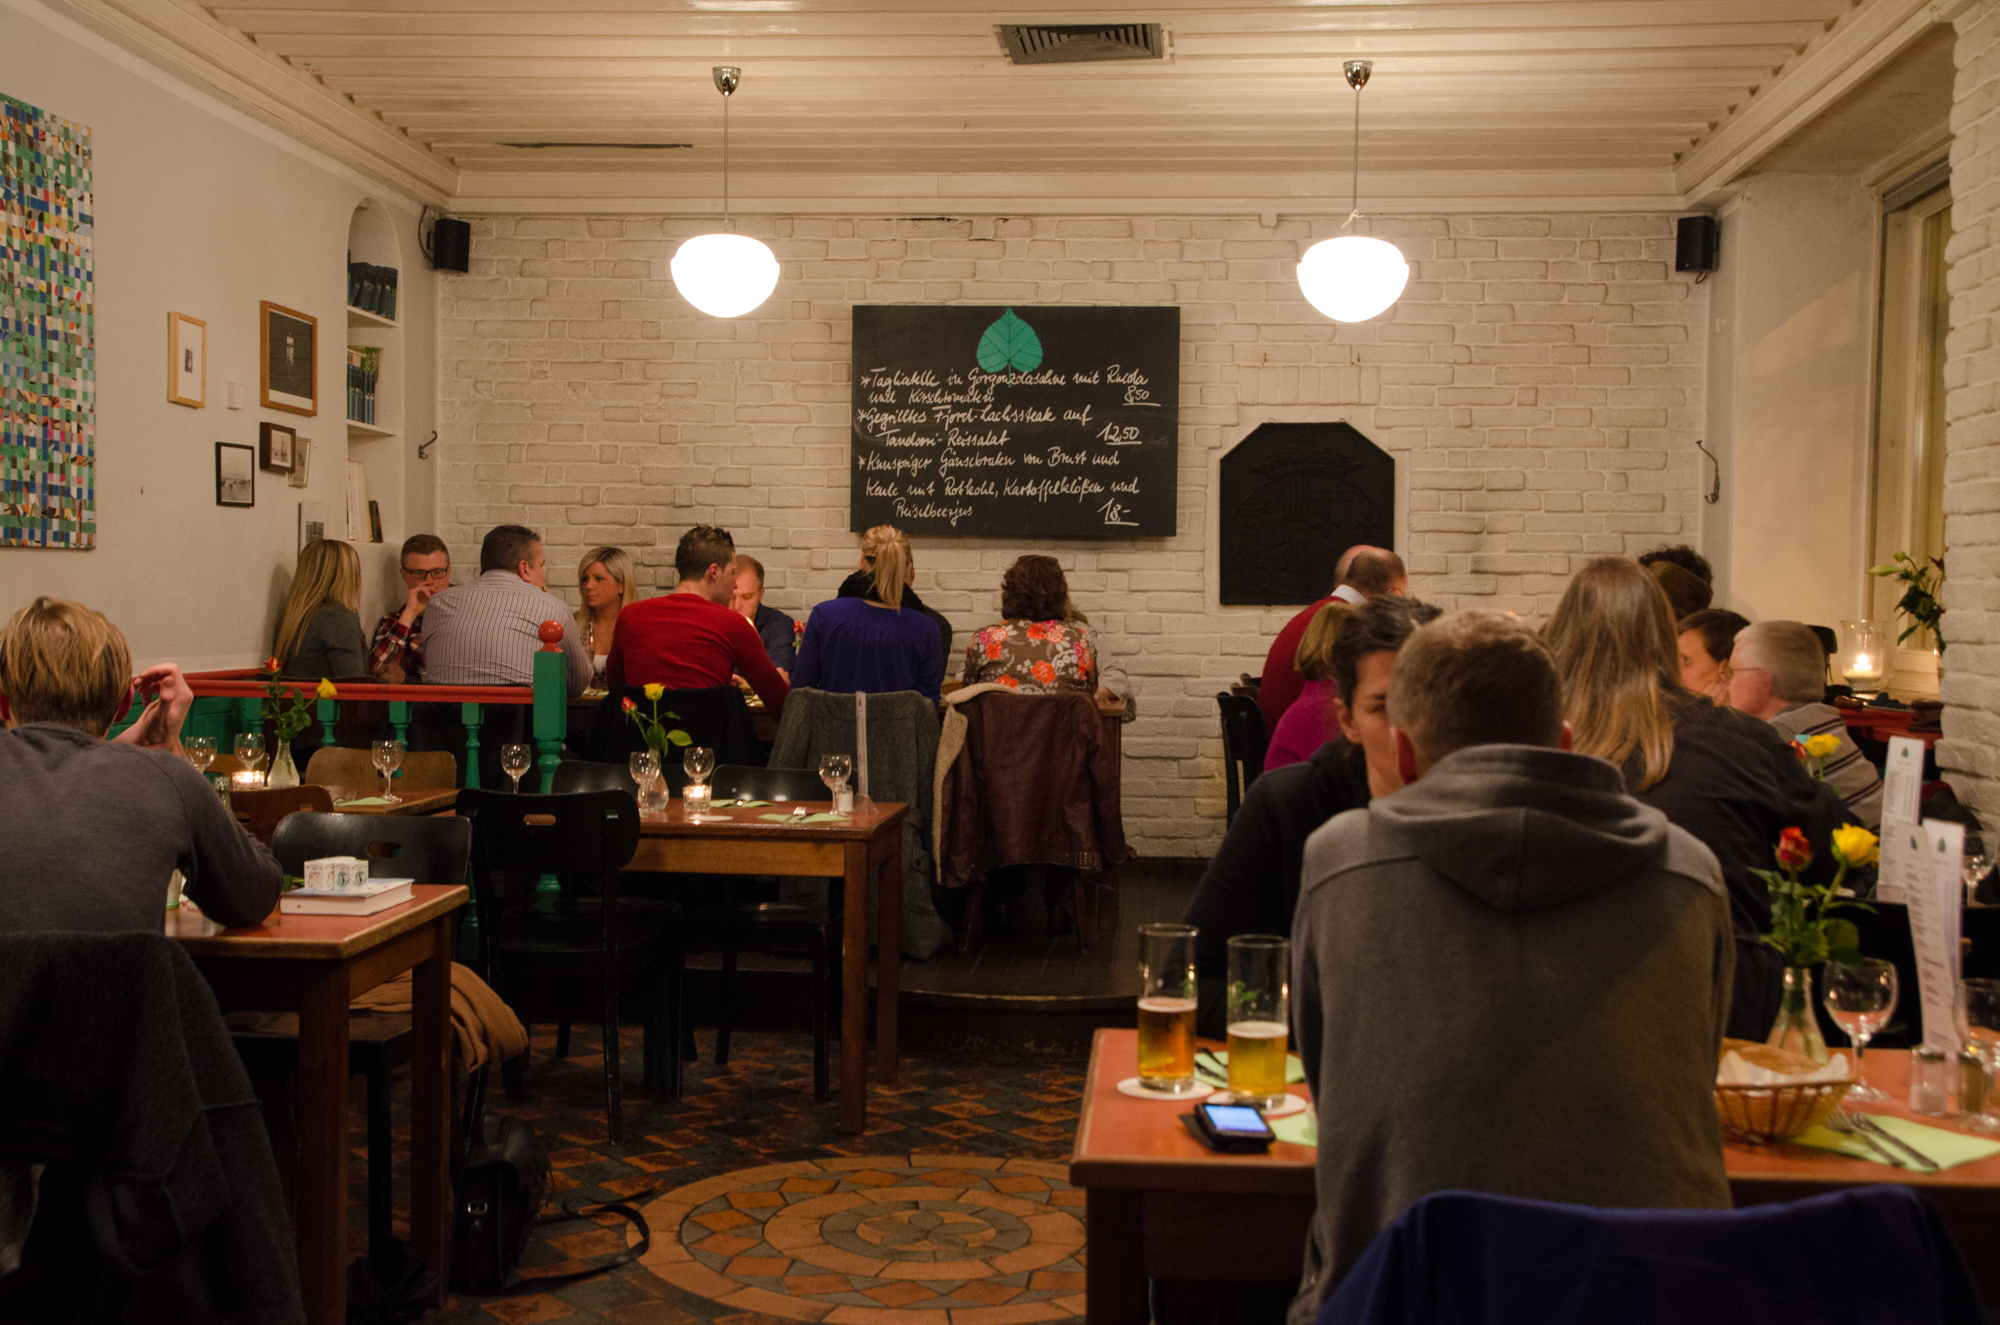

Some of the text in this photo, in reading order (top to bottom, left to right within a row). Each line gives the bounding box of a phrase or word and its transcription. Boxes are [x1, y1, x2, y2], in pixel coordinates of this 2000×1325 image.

[947, 368, 963, 386] in
[968, 367, 1066, 395] Gorgonzolasahne
[1073, 370, 1099, 385] mit
[1107, 364, 1149, 386] Rucola
[868, 388, 995, 405] und Kirschtomaten
[1063, 404, 1093, 426] auf
[1096, 422, 1140, 443] 12,50
[867, 450, 932, 477] Knuspriger
[1024, 453, 1043, 465] von
[1047, 446, 1087, 467] Brust
[1091, 450, 1120, 466] und
[866, 477, 899, 497] Keule
[907, 481, 935, 496] mit
[1003, 476, 1105, 503] Kartoffelklößen
[1110, 477, 1140, 494] und
[892, 497, 973, 527] Preiselbeerjus
